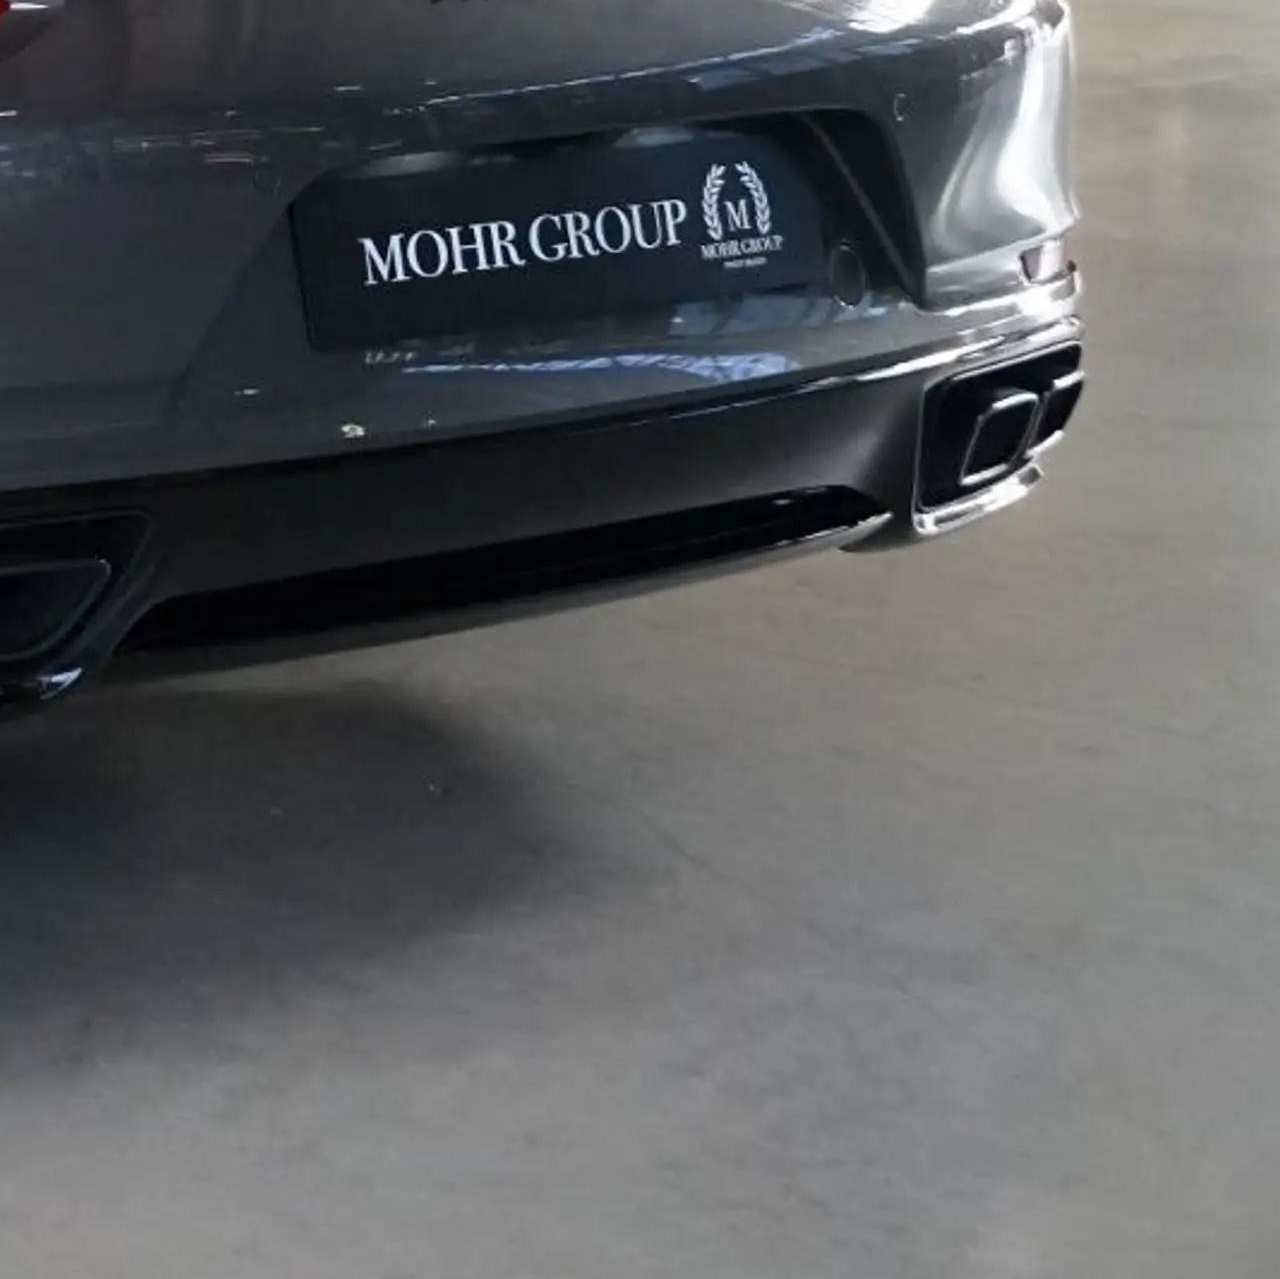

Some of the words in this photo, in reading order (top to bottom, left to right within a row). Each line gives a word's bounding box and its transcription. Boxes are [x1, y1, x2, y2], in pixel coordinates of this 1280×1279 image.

[357, 219, 527, 286] MOHR
[528, 197, 688, 264] GROUP
[723, 198, 752, 232] M
